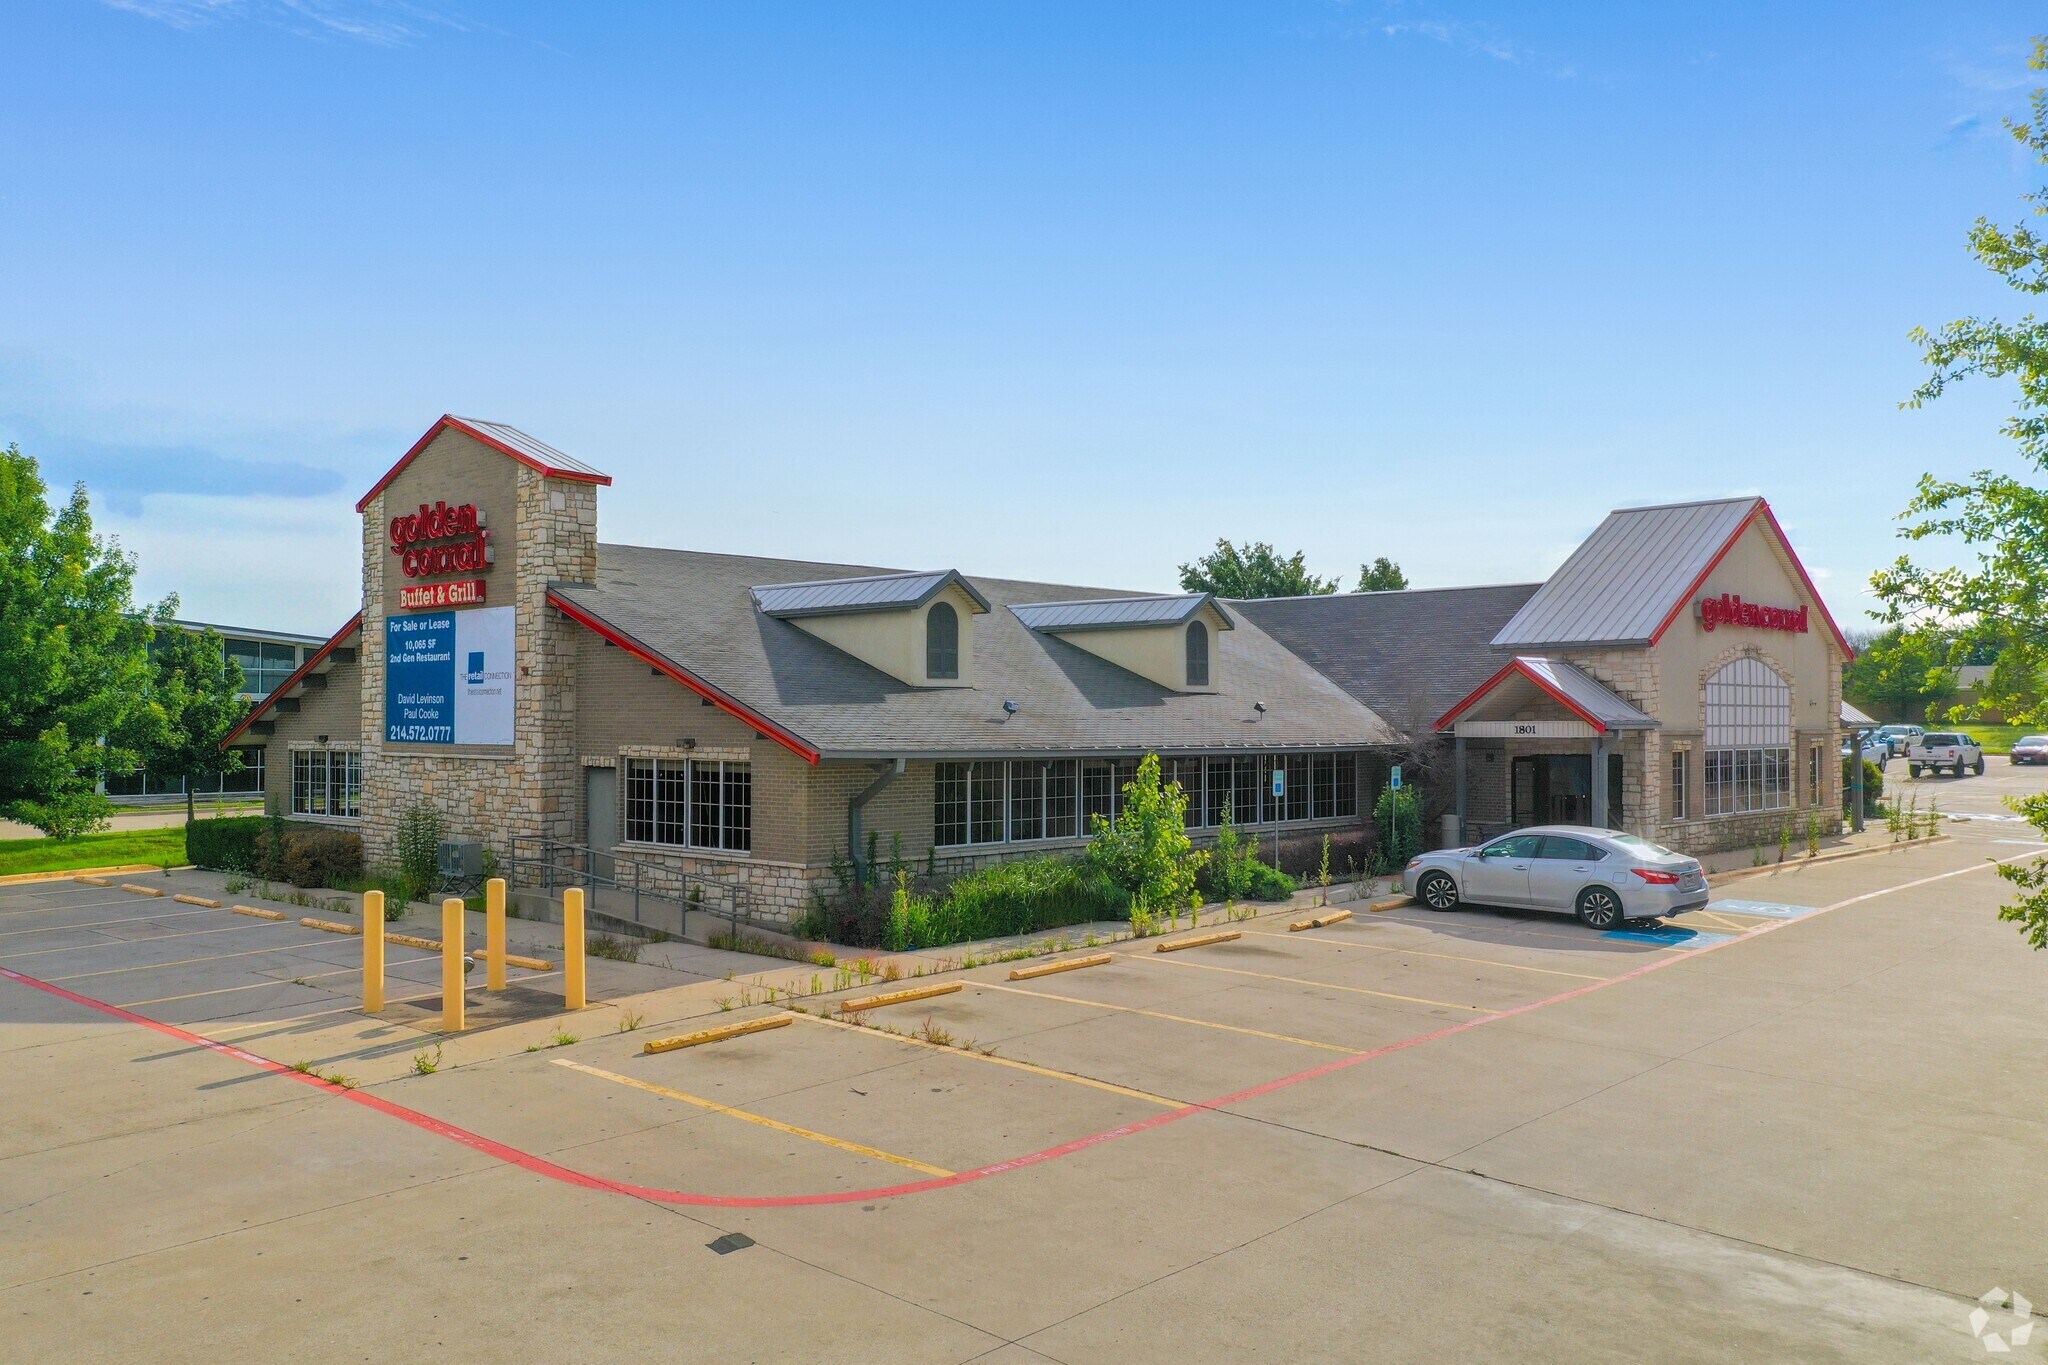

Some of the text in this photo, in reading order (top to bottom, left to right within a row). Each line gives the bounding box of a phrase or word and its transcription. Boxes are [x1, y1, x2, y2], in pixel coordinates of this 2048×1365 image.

[390, 501, 478, 556] golden
[402, 532, 487, 578] corral
[400, 582, 476, 608] Buffet & Grill
[1702, 594, 1759, 632] golden
[390, 618, 450, 633] For Sale or Lease
[405, 638, 436, 652] 10,065 SF
[390, 651, 451, 663] 2nd Gen Restaurant
[397, 692, 445, 704] David Levinson
[403, 707, 440, 719] Paul Cooke
[390, 724, 451, 741] 214.572.0777
[1514, 725, 1536, 734] 1801
